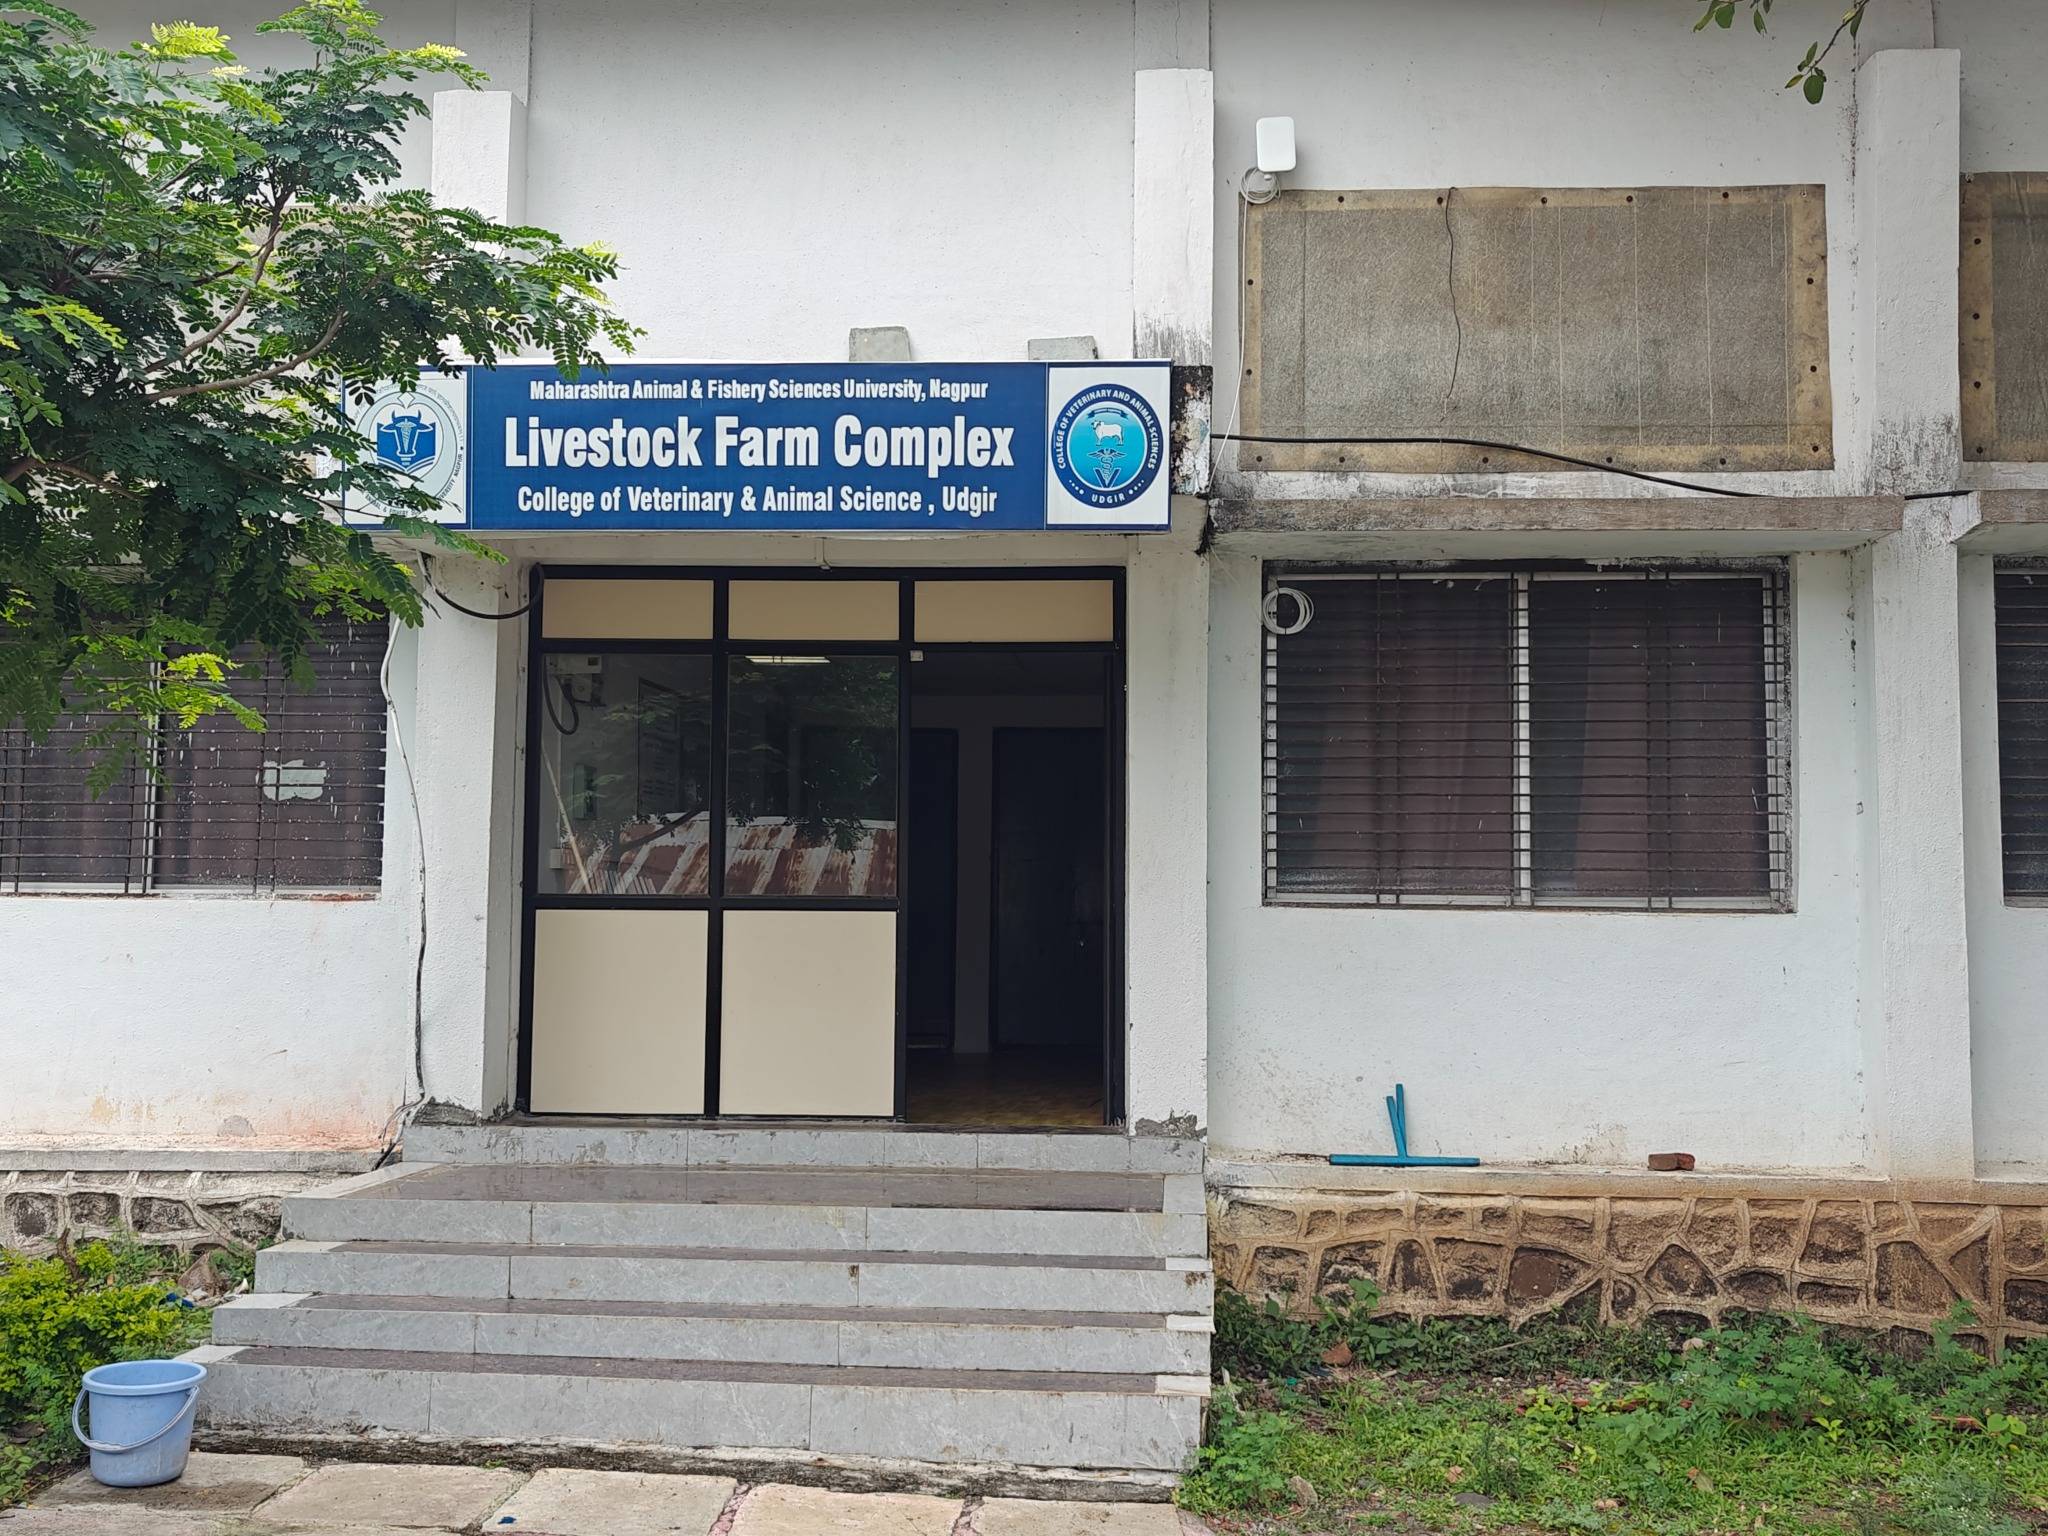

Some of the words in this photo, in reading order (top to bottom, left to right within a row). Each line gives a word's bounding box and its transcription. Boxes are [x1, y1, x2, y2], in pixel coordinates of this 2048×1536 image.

[530, 380, 629, 400] Maharashtra
[632, 379, 688, 399] Animal
[690, 379, 703, 399] &
[707, 379, 767, 403] Fishery
[769, 378, 841, 399] Sciences
[843, 378, 927, 403] University,
[929, 378, 989, 403] Nagpur
[1065, 389, 1112, 418] VETERINARY
[1112, 389, 1131, 402] AND
[1059, 418, 1069, 429] OF
[1130, 398, 1152, 428] ANIMAL
[505, 415, 703, 468] Livestock
[715, 415, 819, 467] Farm
[834, 414, 1015, 478] Complex
[1055, 429, 1066, 470] COLLEGE
[1148, 426, 1159, 469] SCIENCES
[517, 486, 595, 517] College
[600, 486, 621, 511] of
[627, 486, 734, 517] Veterinary
[741, 485, 757, 512] &
[762, 485, 833, 512] Animal
[942, 485, 998, 518] Udgir
[1091, 493, 1126, 504] UDGIR
